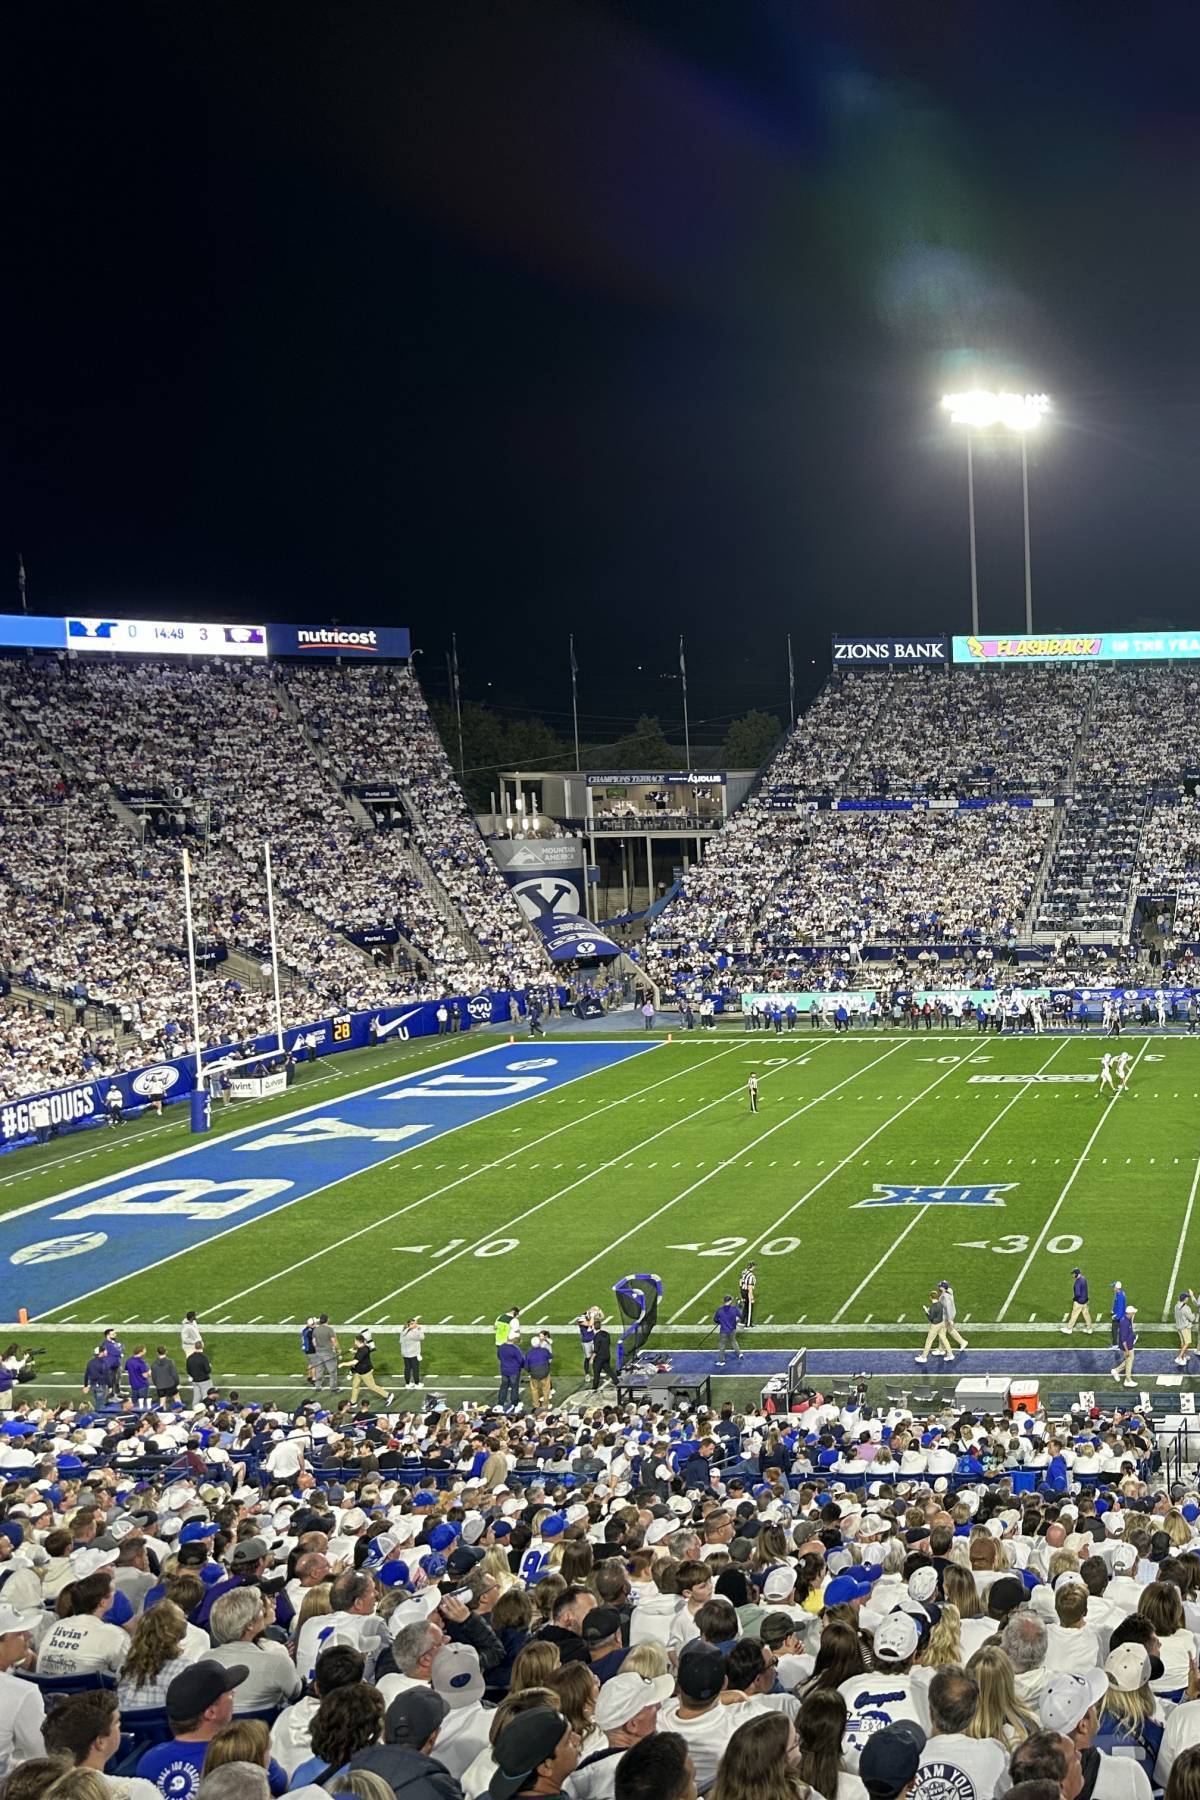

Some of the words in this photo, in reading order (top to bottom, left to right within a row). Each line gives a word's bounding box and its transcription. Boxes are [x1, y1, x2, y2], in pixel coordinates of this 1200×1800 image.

[297, 629, 377, 644] nutricost
[834, 643, 890, 659] ZIONS
[894, 642, 945, 658] BANK
[996, 638, 1096, 658] FLASHBACK
[587, 774, 632, 784] CHAMPIONS
[631, 774, 665, 784] TERRACE
[467, 1002, 493, 1016] byu
[334, 1022, 350, 1041] 28
[49, 1637, 80, 1650] here
